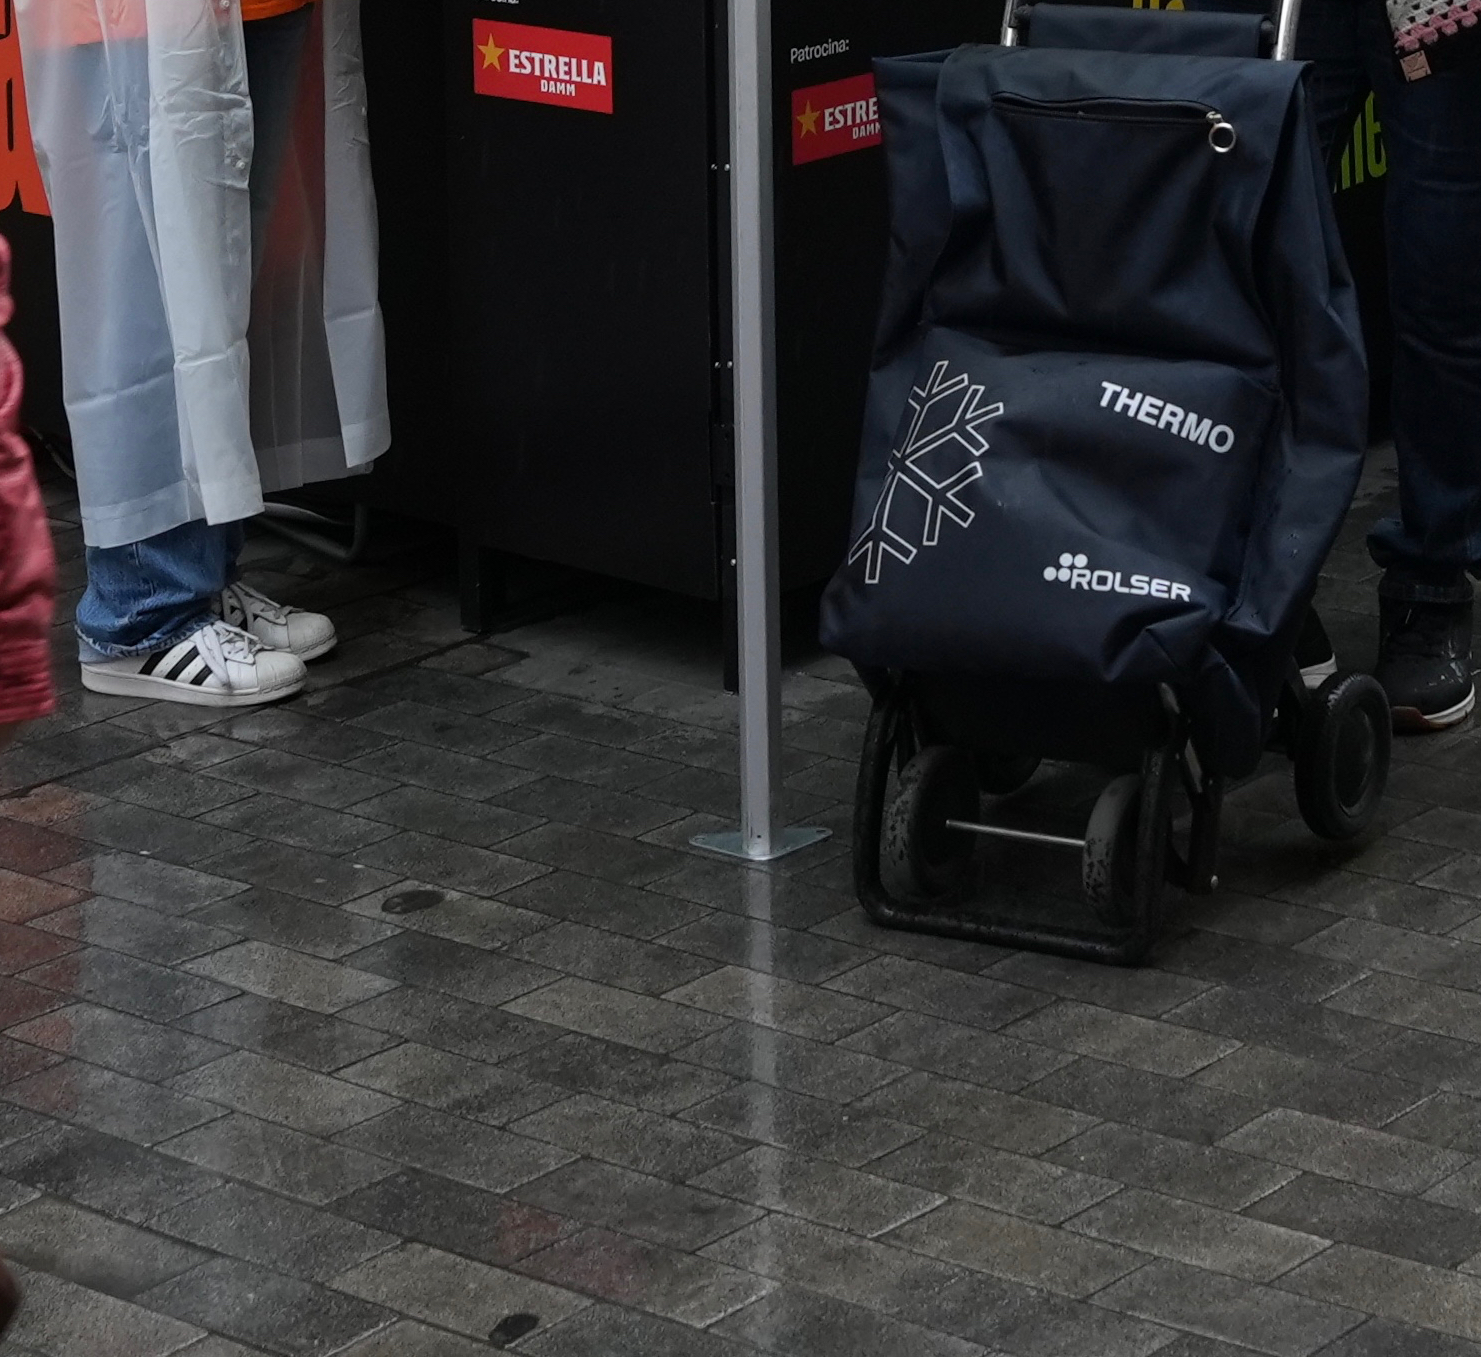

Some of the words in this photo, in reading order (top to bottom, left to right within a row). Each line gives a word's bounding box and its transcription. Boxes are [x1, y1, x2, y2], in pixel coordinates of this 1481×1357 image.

[508, 48, 607, 86] ESTRELLA
[790, 38, 850, 64] Patrocina:
[540, 80, 576, 97] DAMM
[823, 96, 879, 133] ESTRE
[1099, 381, 1235, 454] THERMO
[1070, 568, 1192, 602] ROLSER
